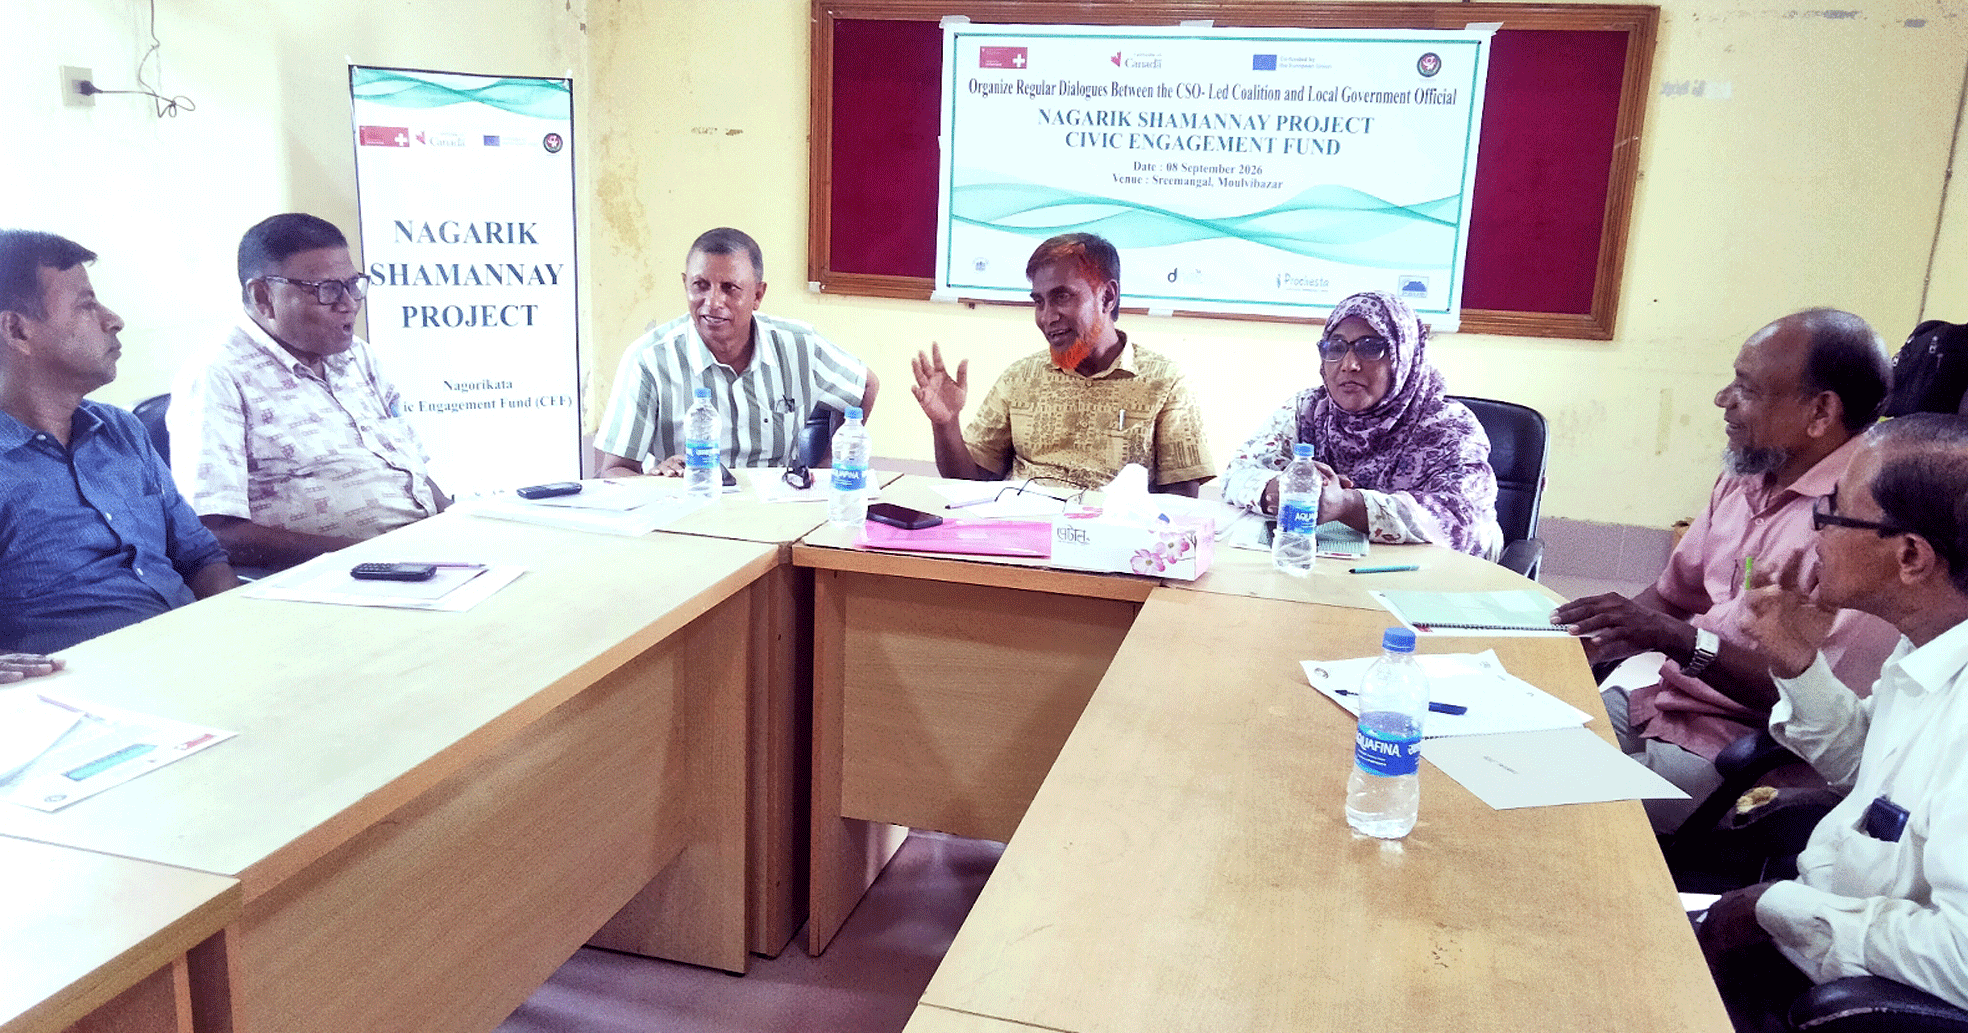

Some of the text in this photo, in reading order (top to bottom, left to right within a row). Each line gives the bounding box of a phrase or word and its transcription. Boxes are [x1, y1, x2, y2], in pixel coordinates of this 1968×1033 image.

[968, 78, 1457, 105] Organize Regular Dialogues Between the CSO- Led Coalition and Local Government Official
[1038, 108, 1375, 134] NAGARIK SHAMANNAY PROJECT
[1065, 131, 1341, 155] CIVIC ENGAGEMENT FUND
[1133, 161, 1157, 171] Date
[1166, 162, 1178, 172] 08
[1181, 162, 1236, 175] September
[1238, 164, 1263, 175] 2026
[1112, 173, 1143, 184] Venue
[1152, 175, 1214, 188] Sreemangal,
[1218, 177, 1284, 189] Moulvibazar
[393, 220, 539, 244] NAGARIK
[369, 263, 565, 286] SHAMANNAY
[401, 304, 539, 328] PROJECT
[444, 379, 513, 392] Nagorikata
[418, 399, 496, 413] Engagement
[500, 397, 532, 408] Fund
[535, 396, 573, 409] (CEF)
[1355, 732, 1402, 759] QUAFINA
